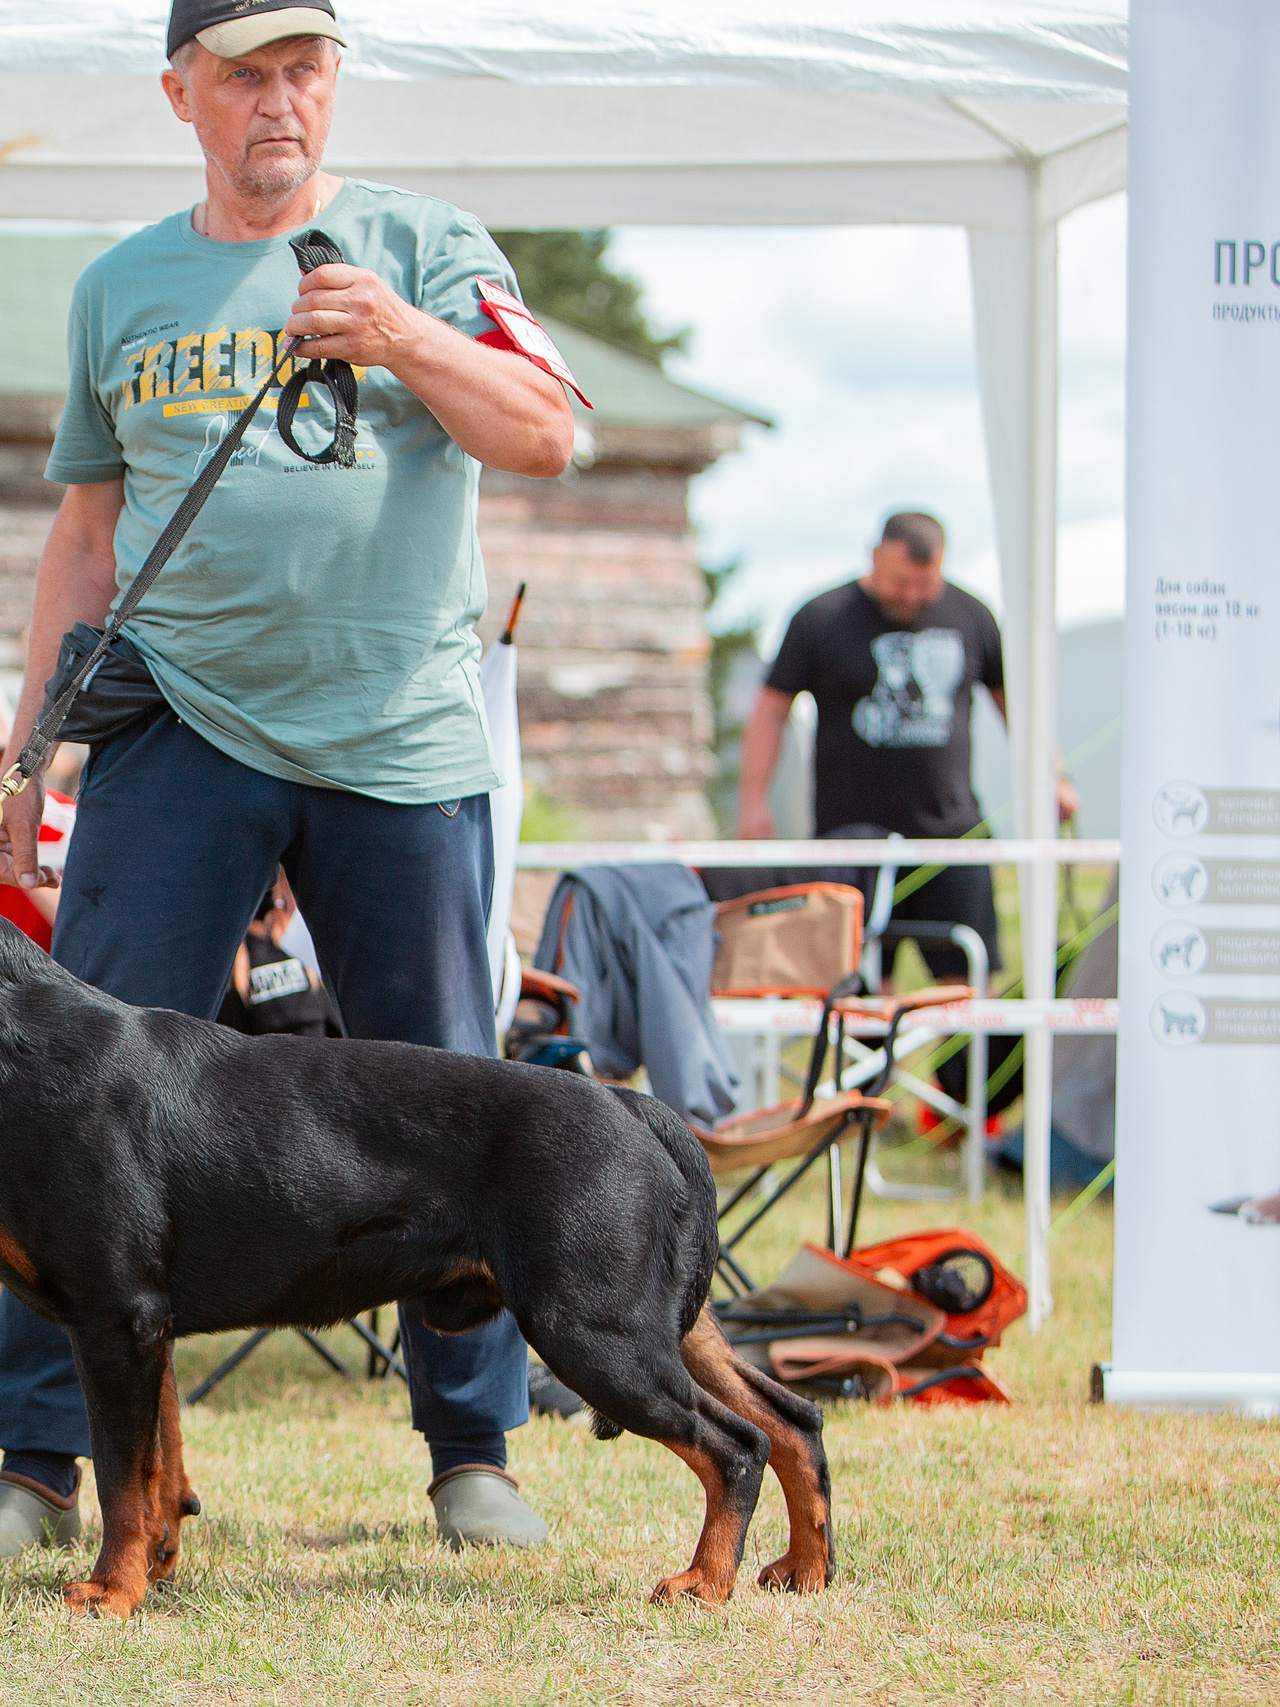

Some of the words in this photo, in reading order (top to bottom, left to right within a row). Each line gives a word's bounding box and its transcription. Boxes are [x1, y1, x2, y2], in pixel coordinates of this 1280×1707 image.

[124, 327, 366, 409] FREEDO
[173, 401, 198, 414] NEW
[201, 398, 254, 410] CREATIV
[283, 463, 320, 473] BELIEVE
[322, 463, 331, 471] IN
[1186, 578, 1226, 596] собак
[1225, 599, 1241, 618] 10
